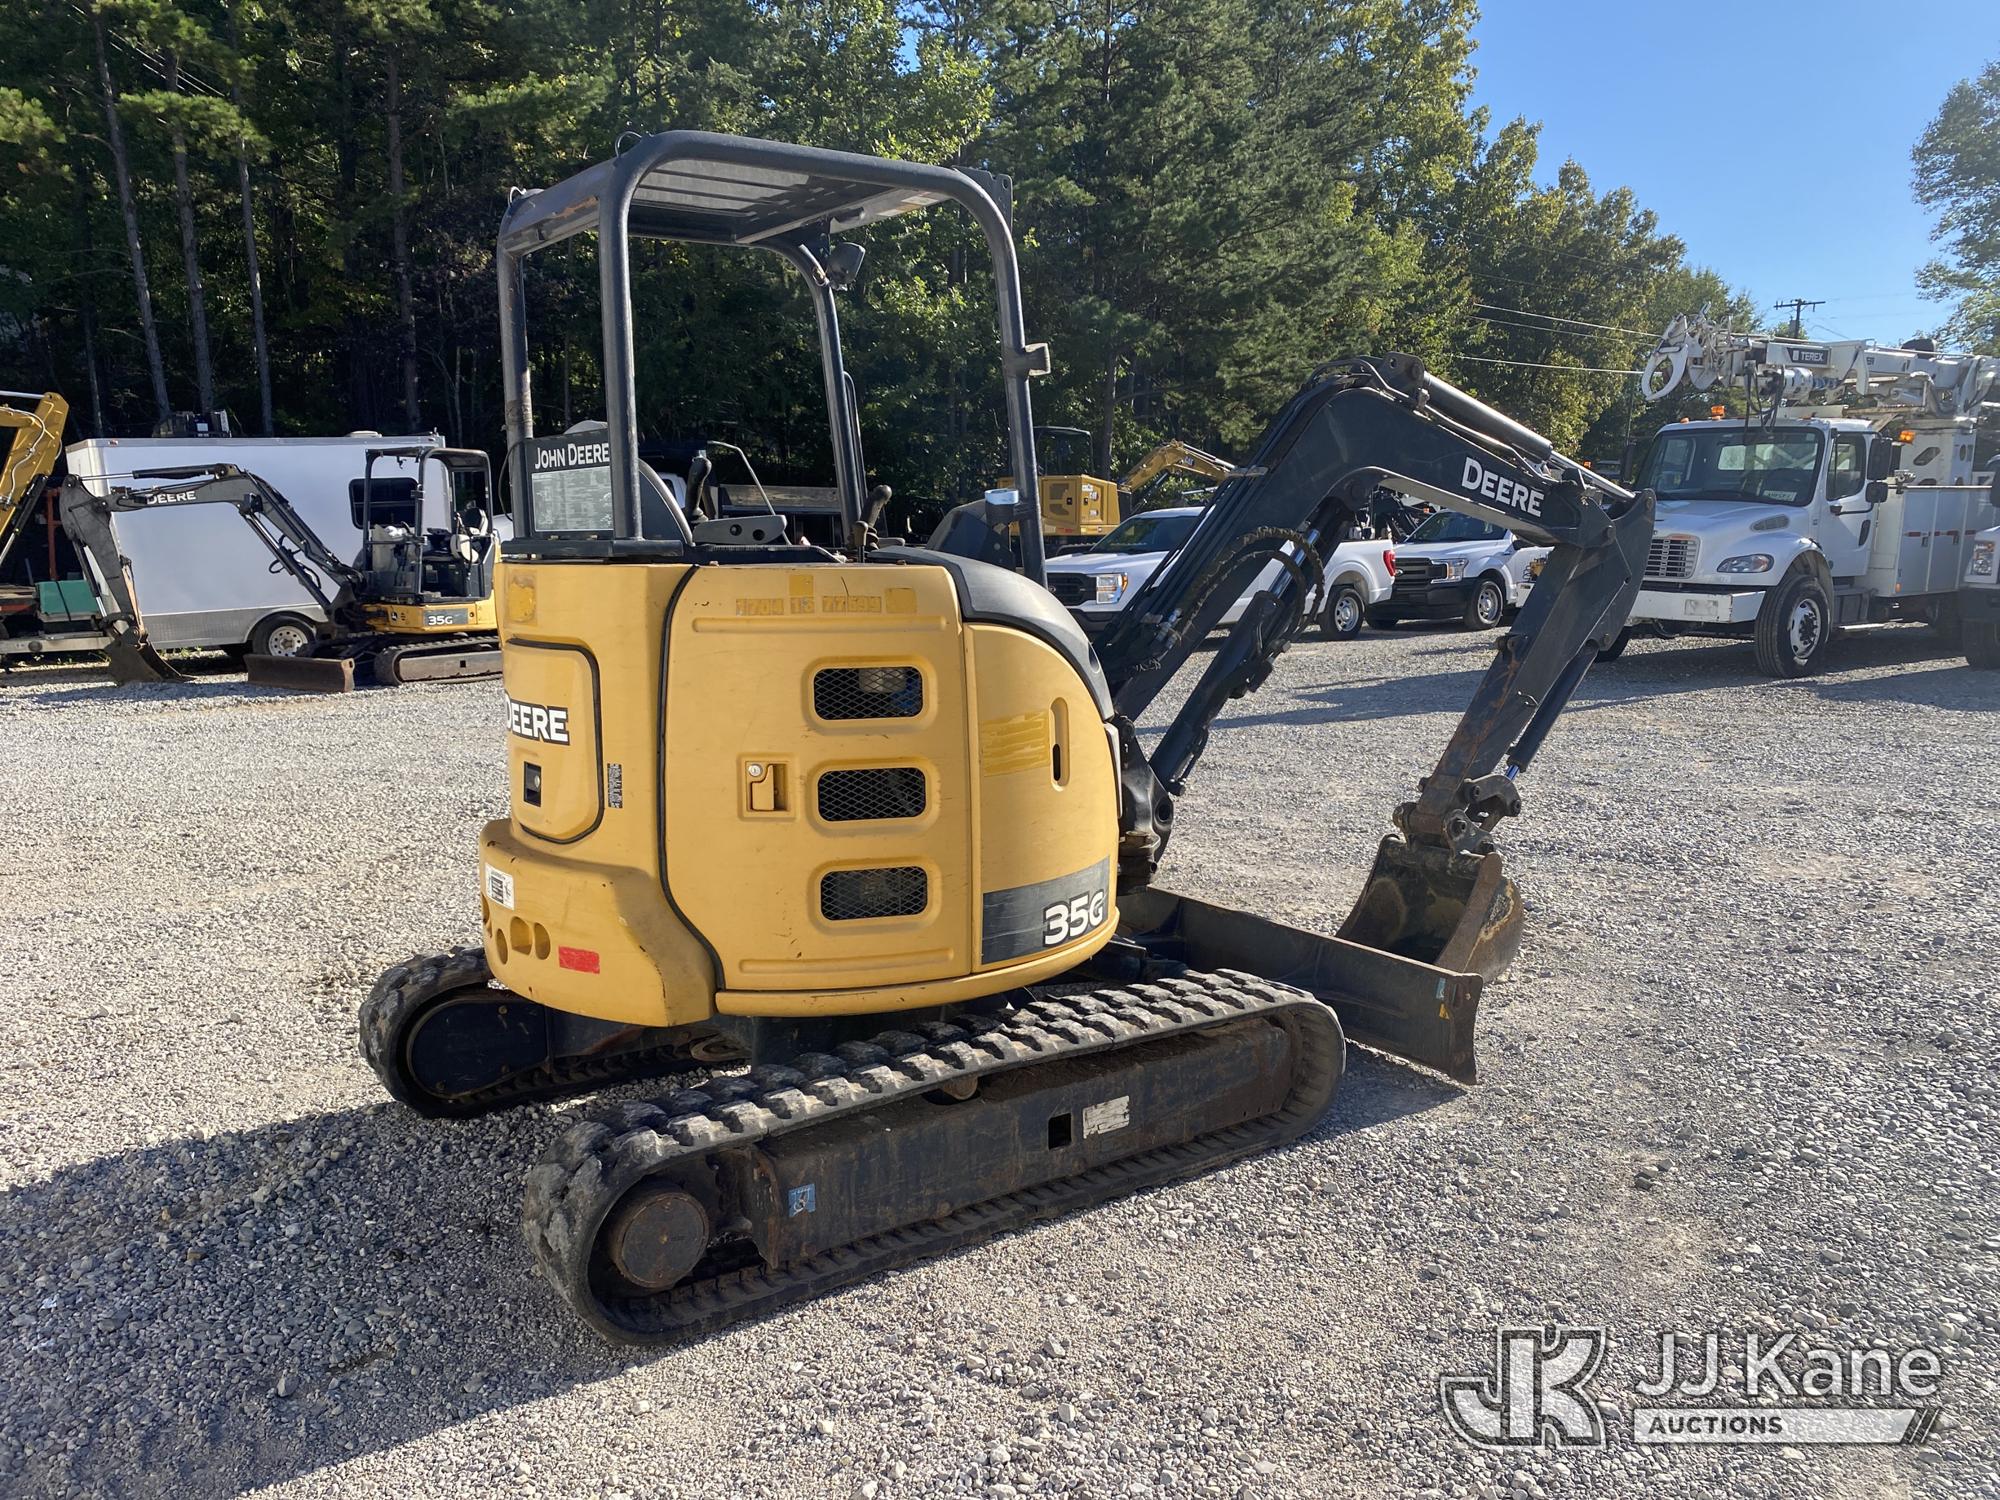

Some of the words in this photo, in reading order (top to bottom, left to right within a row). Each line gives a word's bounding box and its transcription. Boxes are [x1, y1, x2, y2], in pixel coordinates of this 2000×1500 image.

[1801, 351, 1824, 361] TEREX
[534, 447, 566, 470] JOHN
[567, 442, 611, 466] DEERE
[145, 490, 196, 504] DEERE
[1461, 456, 1545, 517] DEERE
[428, 615, 453, 625] 35G
[1044, 890, 1105, 945] 35G
